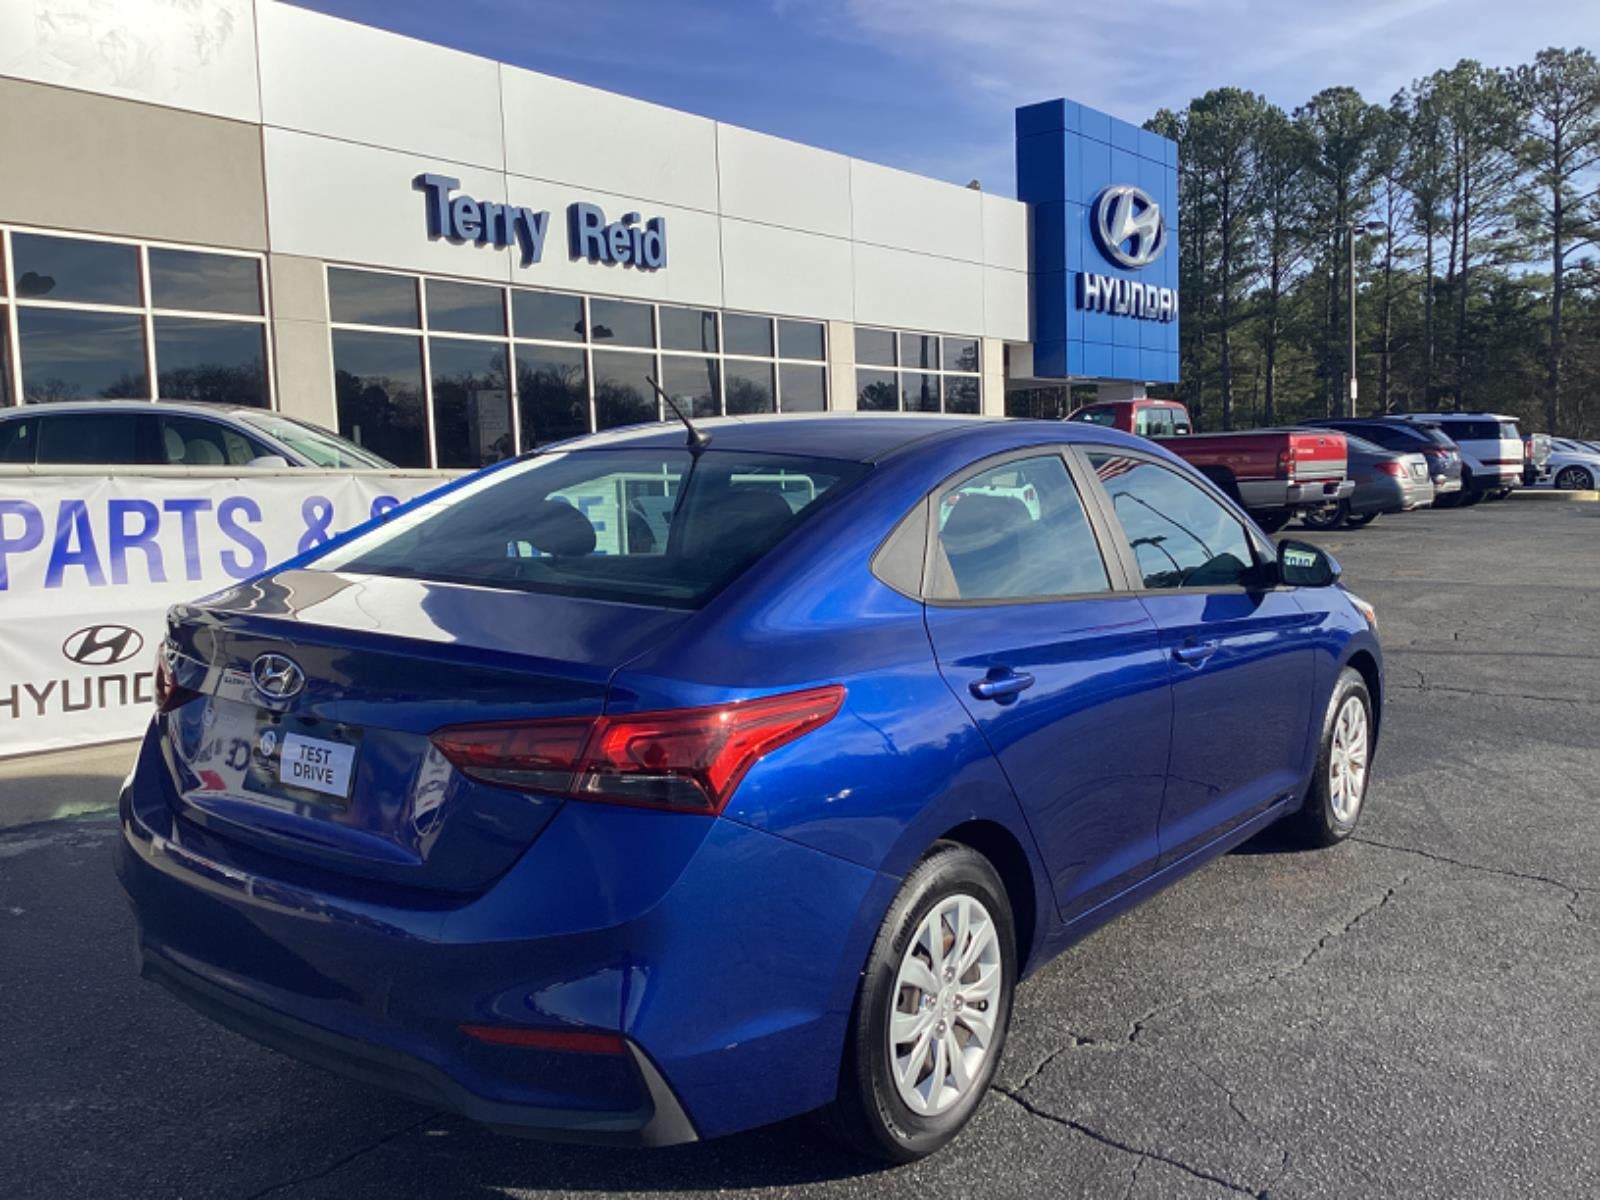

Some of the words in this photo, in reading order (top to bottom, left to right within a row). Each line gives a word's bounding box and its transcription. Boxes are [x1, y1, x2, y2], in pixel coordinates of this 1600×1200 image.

[412, 173, 550, 268] Terry
[567, 201, 667, 272] Reid
[1078, 272, 1179, 323] HYUNDAI
[0, 495, 267, 591] PARTS
[297, 496, 340, 555] &
[293, 761, 334, 785] DRIVE
[299, 744, 332, 765] TEST
